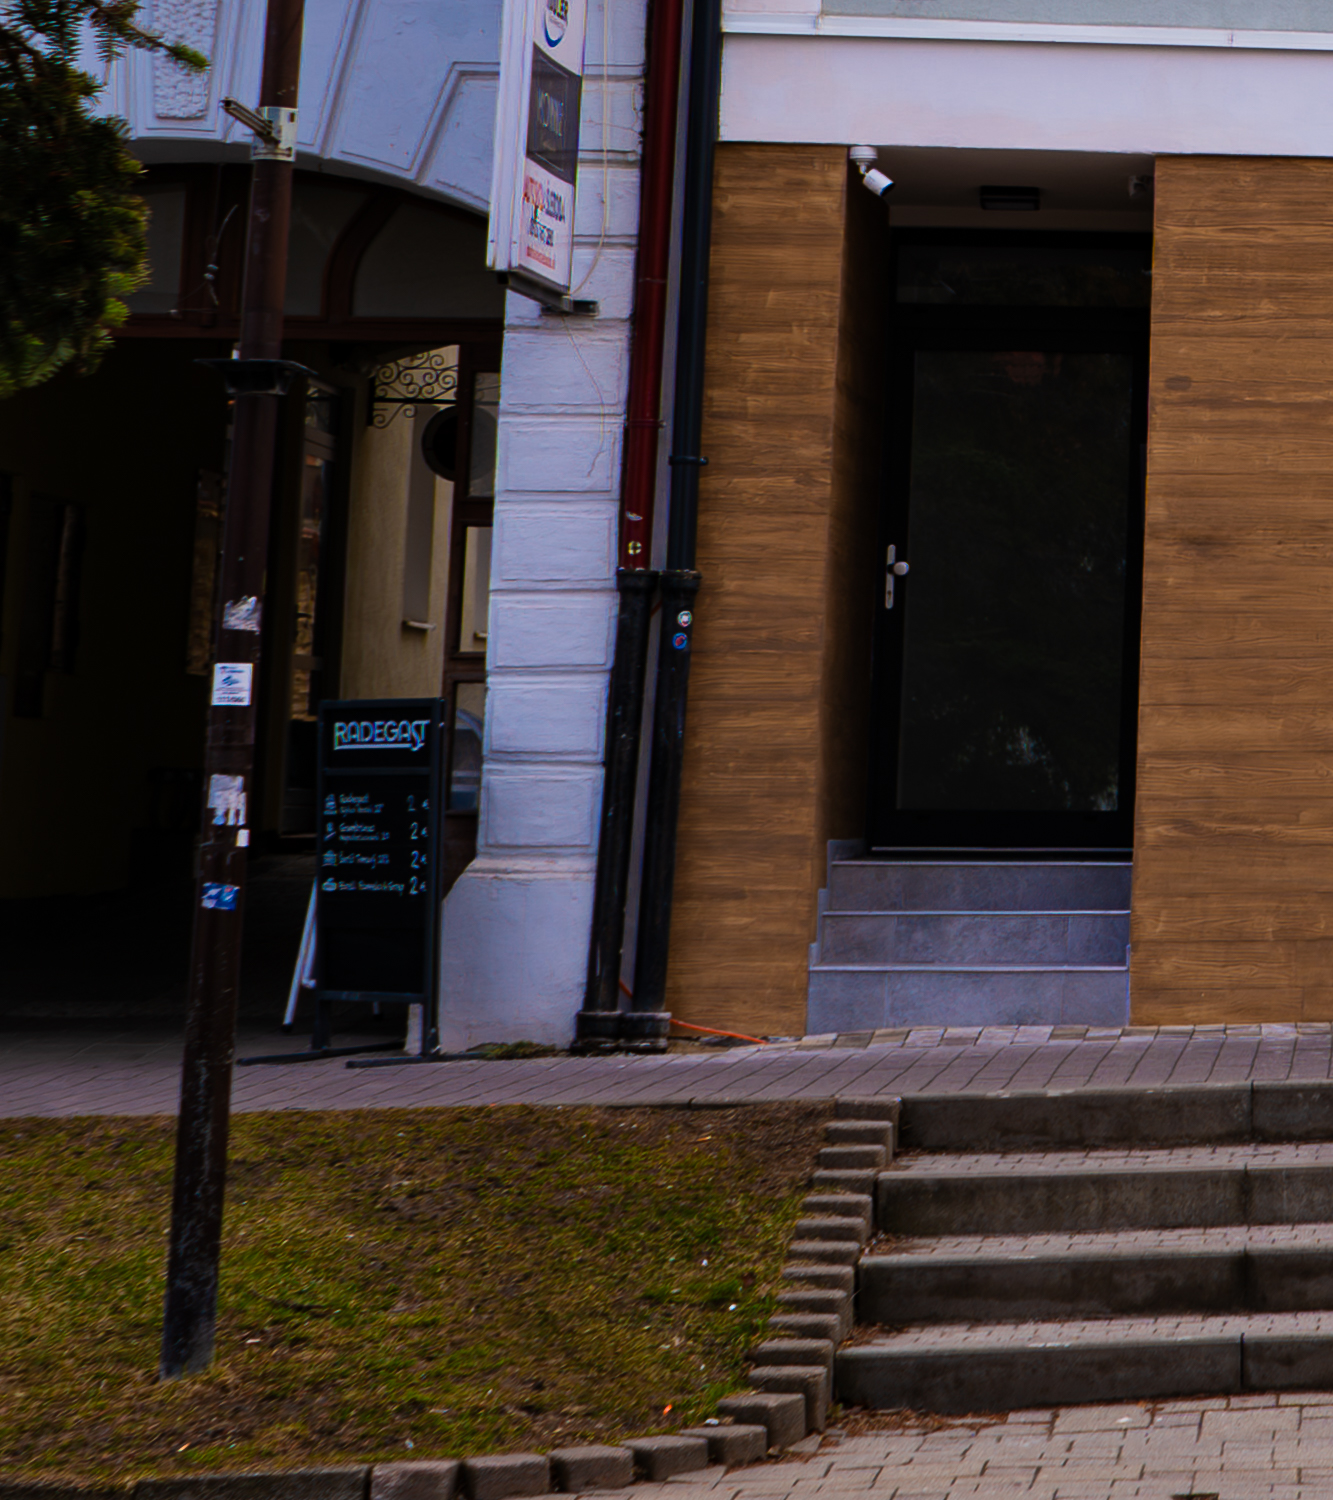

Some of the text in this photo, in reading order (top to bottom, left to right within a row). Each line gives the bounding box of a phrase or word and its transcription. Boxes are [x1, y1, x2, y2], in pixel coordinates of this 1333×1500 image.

[334, 719, 431, 751] RADEGAST
[410, 821, 419, 840] 2
[410, 850, 420, 869] 2
[409, 876, 419, 895] 2
